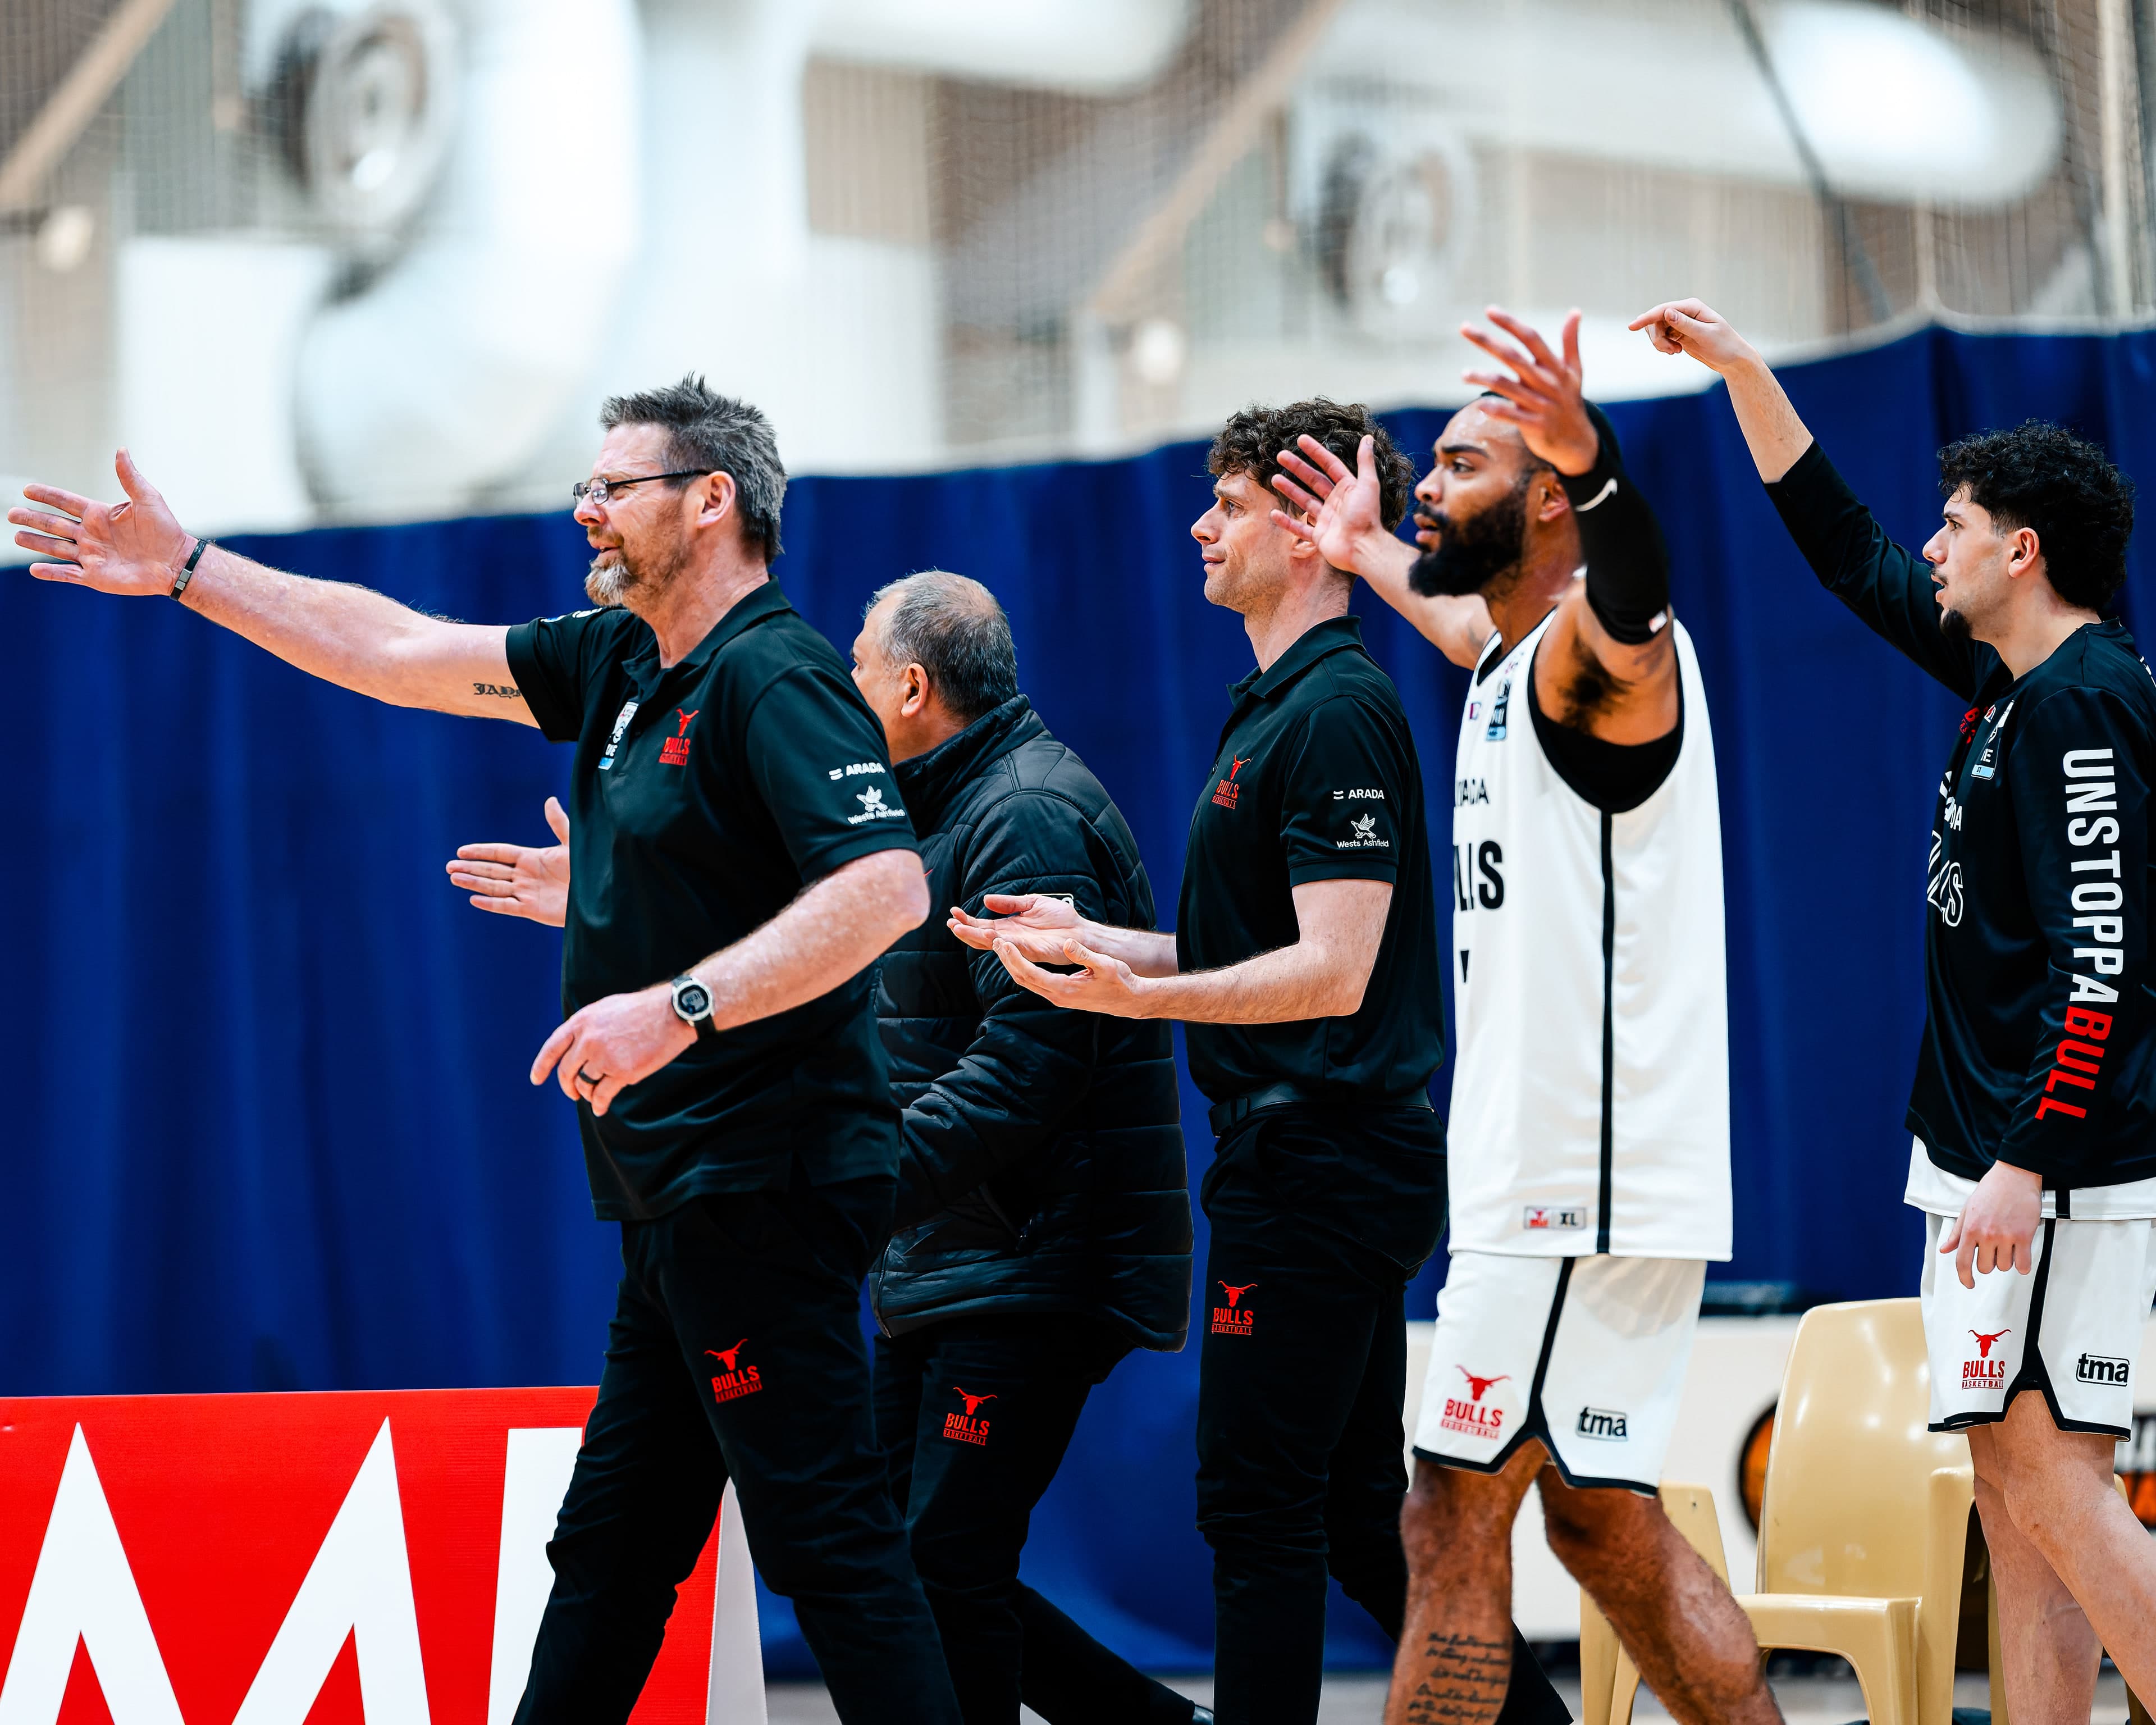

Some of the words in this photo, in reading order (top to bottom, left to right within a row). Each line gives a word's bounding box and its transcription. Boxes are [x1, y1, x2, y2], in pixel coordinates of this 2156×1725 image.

[846, 762, 886, 776] ARADA
[1216, 779, 1240, 799] BULLS
[1348, 788, 1385, 800] ARADA
[1336, 839, 1362, 848] Wests
[1363, 838, 1390, 847] Ashfield
[1212, 1307, 1254, 1326] BULLS
[1962, 1360, 2006, 1379] BULLS
[2078, 1352, 2130, 1383] tma
[711, 1365, 760, 1393] BULLS
[1962, 1380, 2004, 1389] BASKETBALL
[1445, 1399, 1503, 1427] BULLS
[1578, 1406, 1627, 1437] tma
[944, 1413, 990, 1436] BULLS
